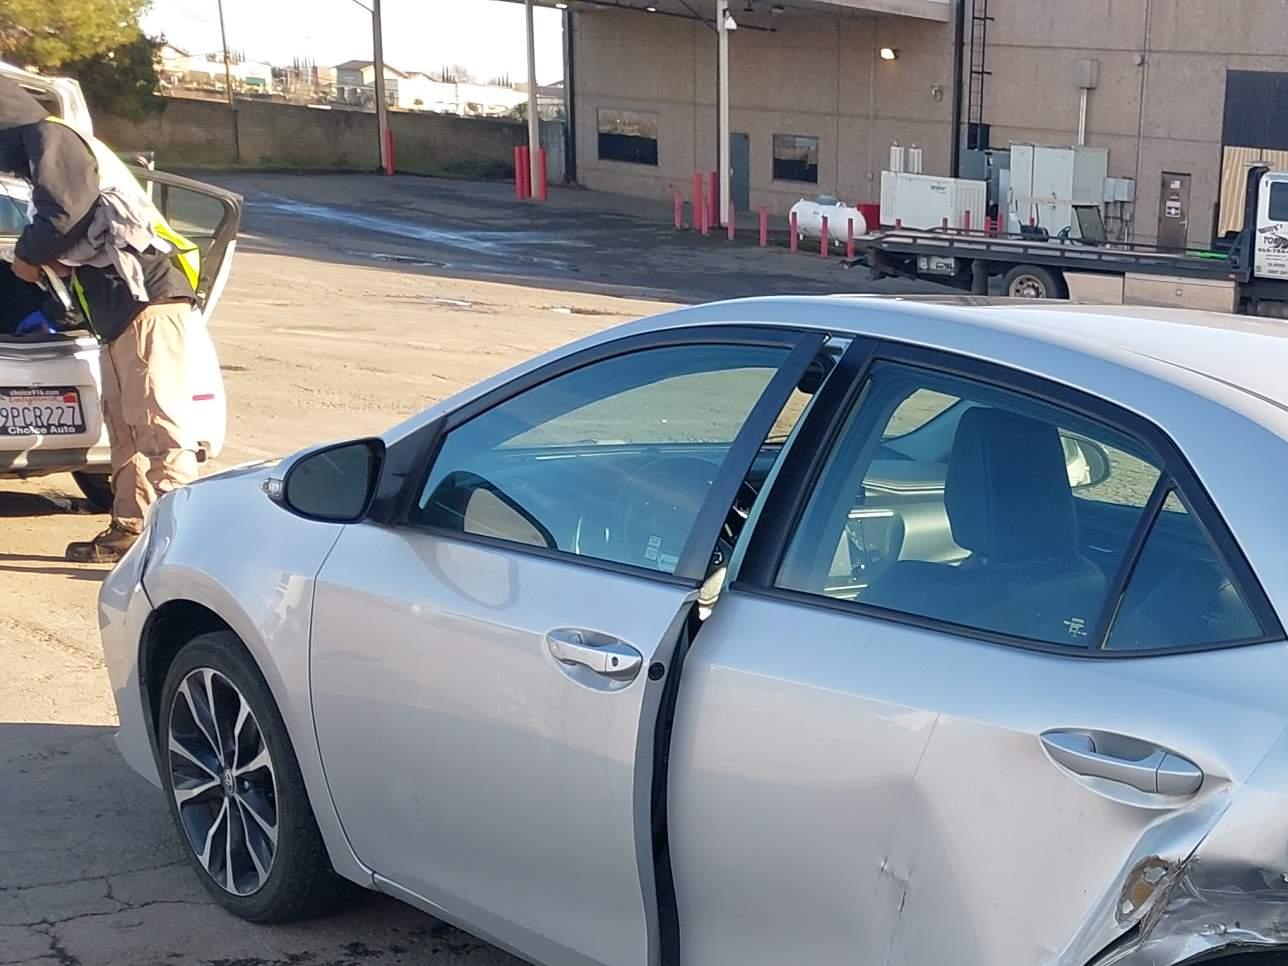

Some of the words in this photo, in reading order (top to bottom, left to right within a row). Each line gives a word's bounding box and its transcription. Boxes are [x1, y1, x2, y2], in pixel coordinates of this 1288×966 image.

[0, 406, 75, 427] 9PCR227
[7, 425, 48, 434] Choce
[50, 425, 76, 433] Auto
